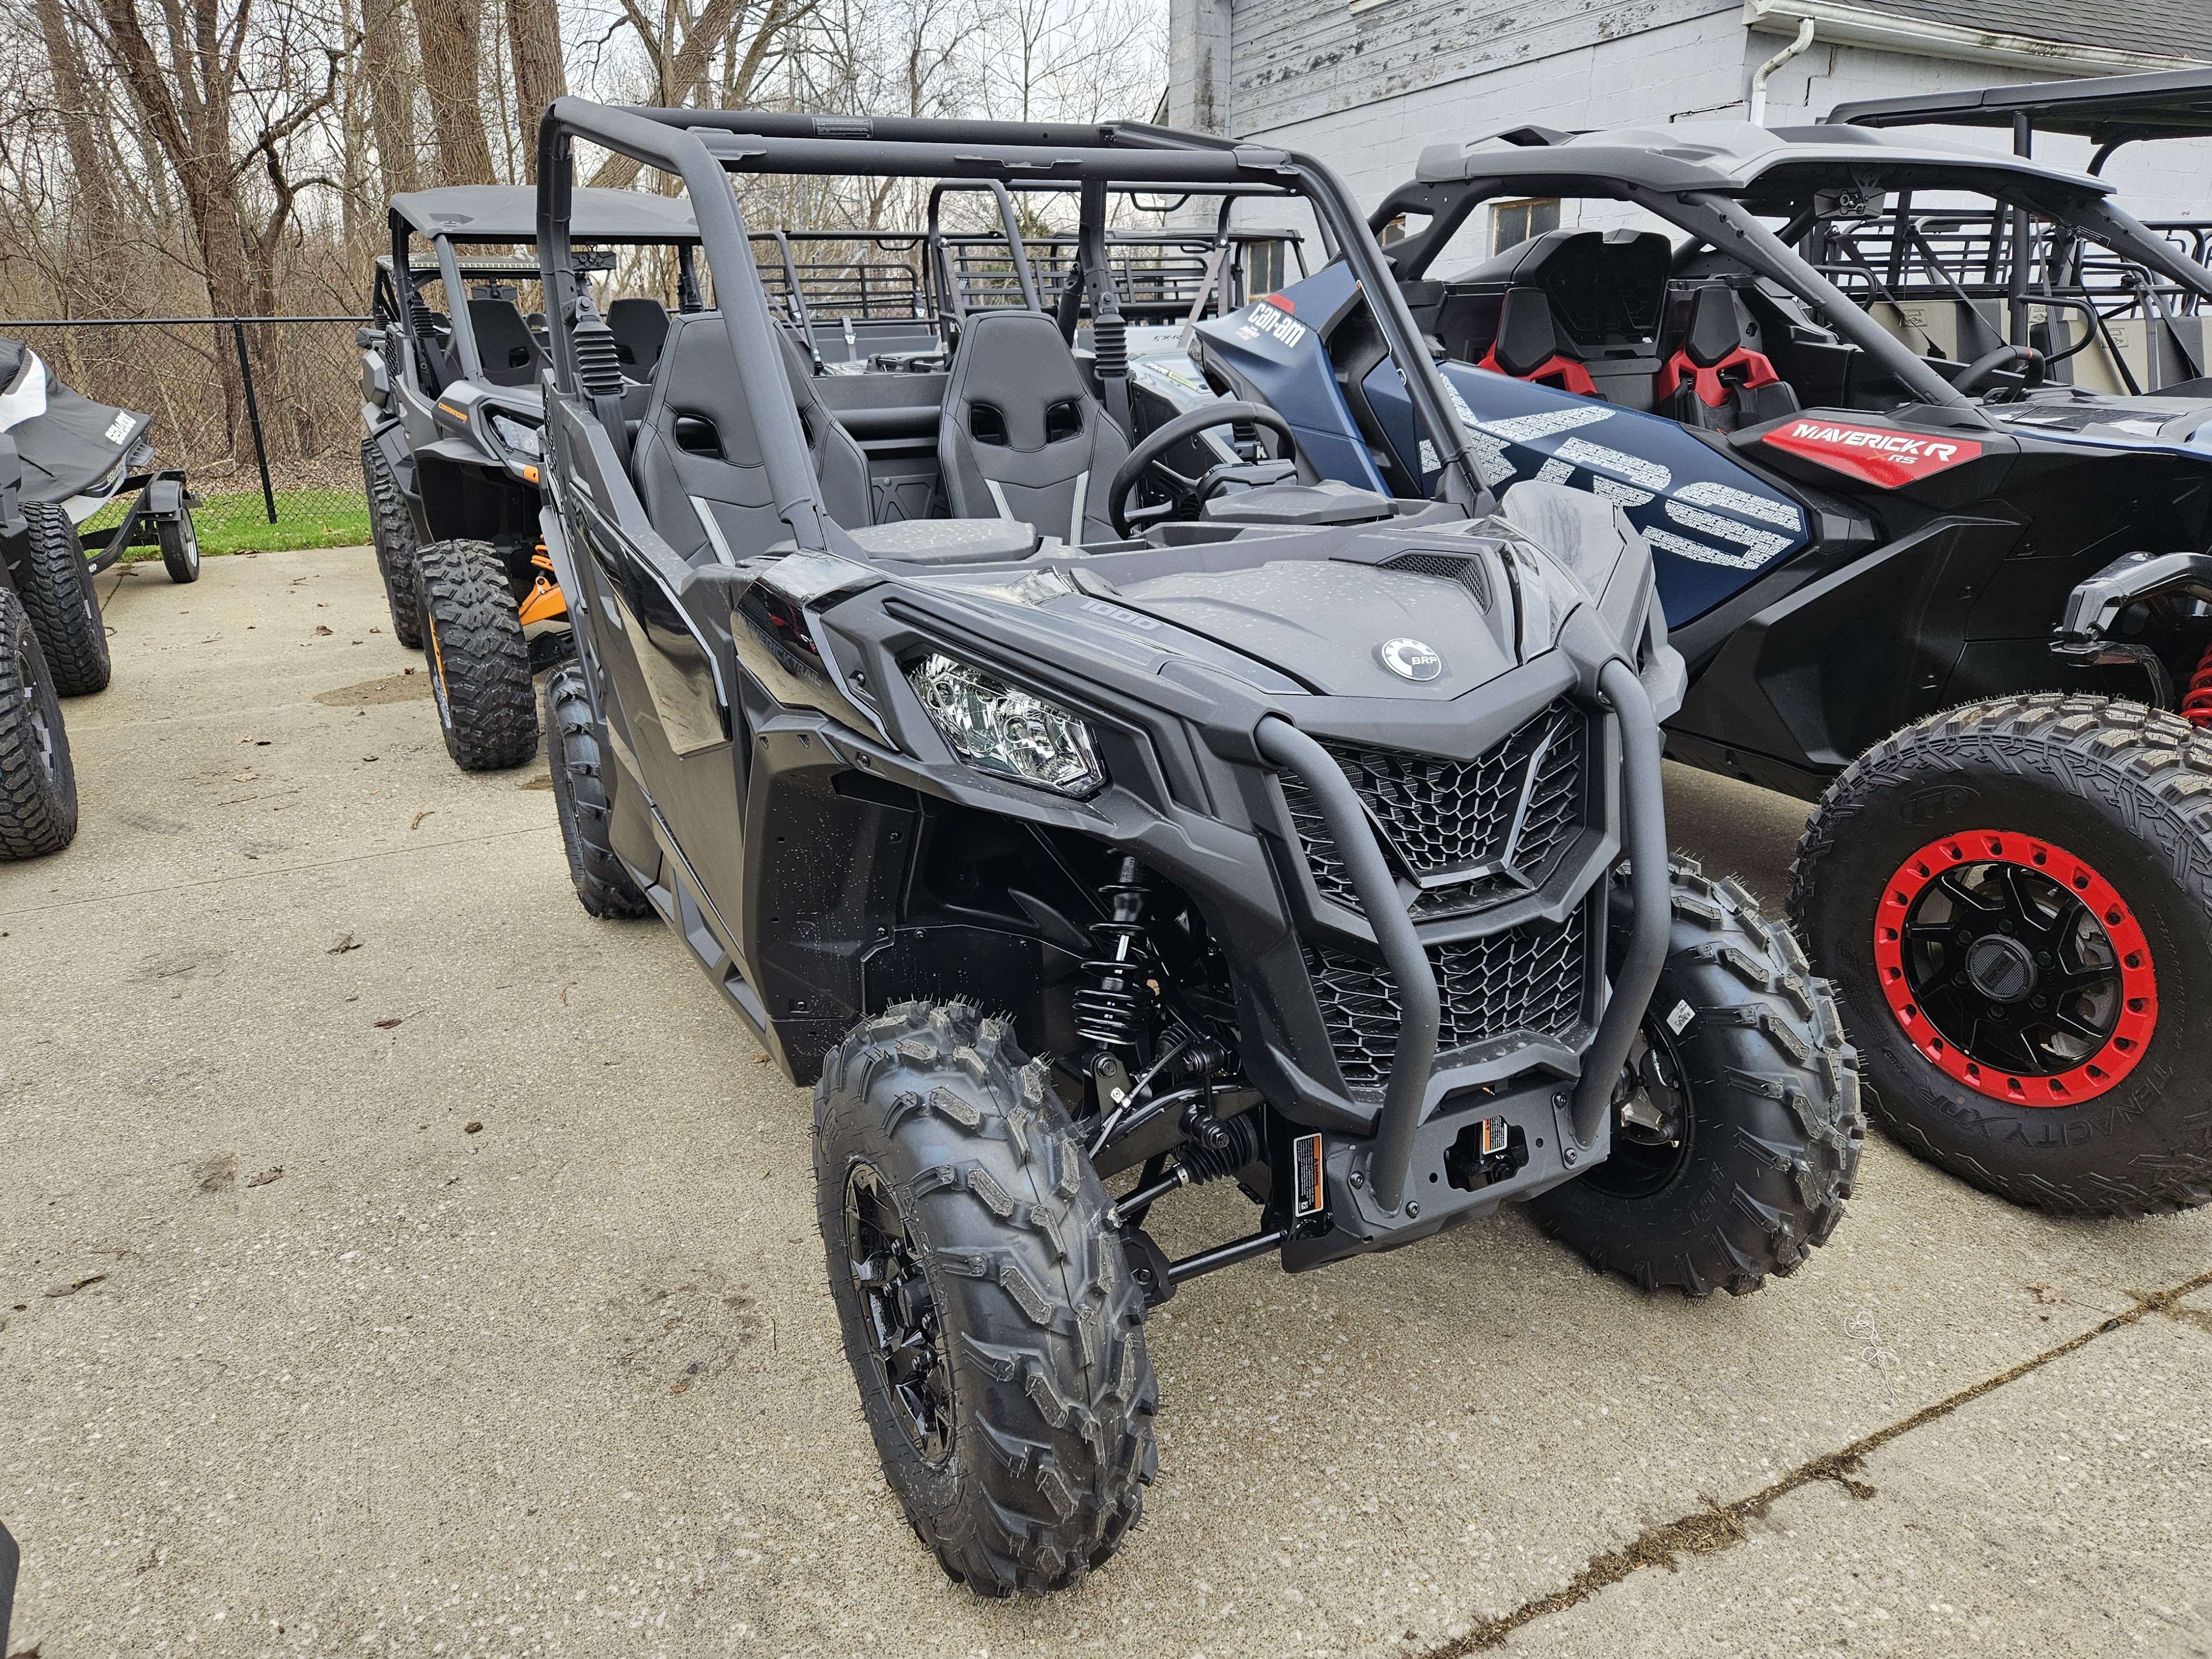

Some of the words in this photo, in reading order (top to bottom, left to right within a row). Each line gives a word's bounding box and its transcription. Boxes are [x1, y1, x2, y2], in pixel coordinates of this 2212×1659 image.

[1248, 303, 1306, 348] can-am
[1792, 424, 1928, 455] MAVERICK
[1924, 443, 1957, 462] R
[1080, 600, 1161, 630] 1000
[735, 612, 793, 670] MAVERICK
[791, 658, 823, 687] TRAIL
[1411, 656, 1438, 665] BRP
[2003, 1063, 2174, 1147] TENACITY
